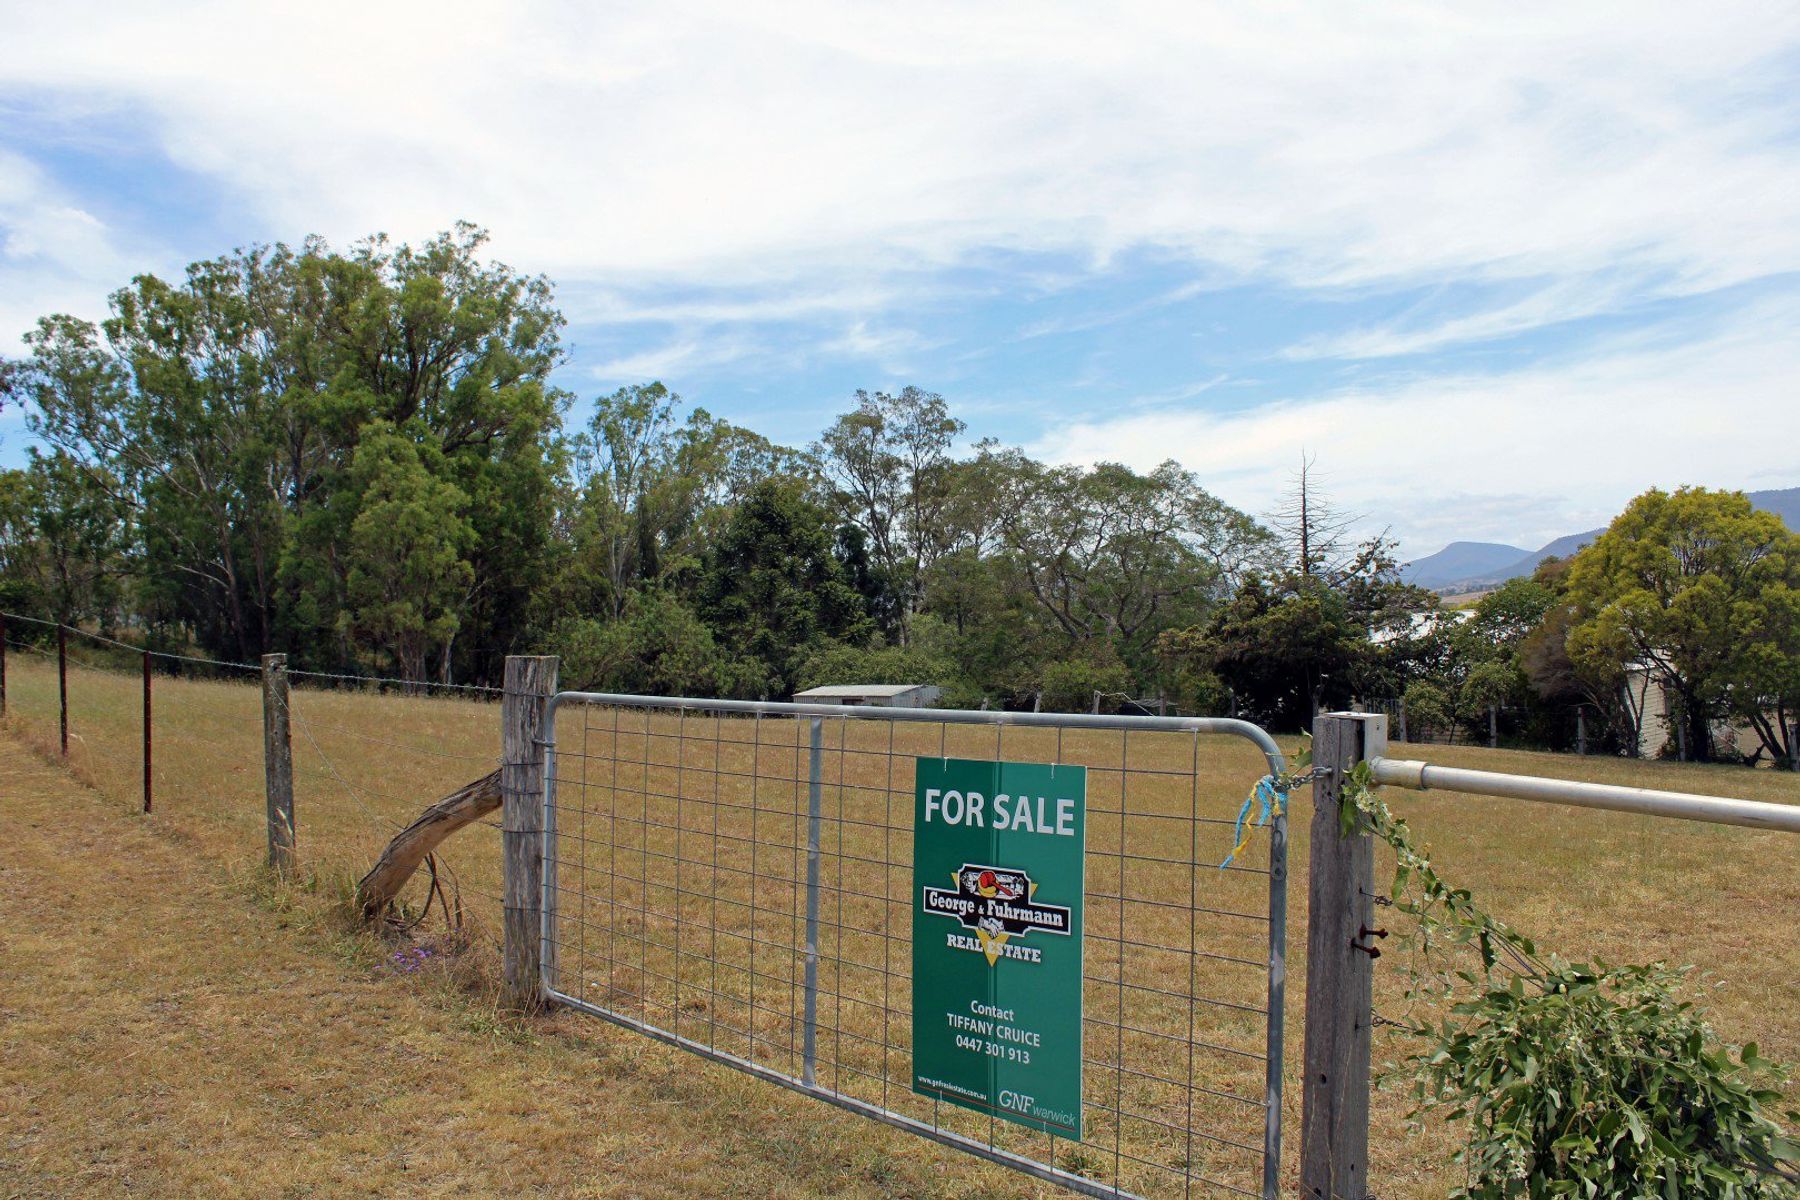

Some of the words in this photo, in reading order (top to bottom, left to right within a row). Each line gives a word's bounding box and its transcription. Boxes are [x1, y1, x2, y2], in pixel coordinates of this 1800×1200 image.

[925, 788, 985, 828] FOR
[992, 793, 1075, 837] SALE
[929, 891, 975, 916] George
[978, 904, 985, 914] &
[986, 901, 1064, 927] Fuhrmann
[946, 933, 983, 953] REAL
[987, 939, 1042, 963] ESTATE
[970, 1000, 1015, 1022] Contact
[946, 1012, 994, 1037] TIFFANY
[996, 1025, 1041, 1047] CRUICE
[956, 1034, 983, 1053] 0447
[985, 1041, 1005, 1058] 301
[1008, 1048, 1031, 1065] 913
[999, 1089, 1034, 1113] GNF
[1032, 1105, 1076, 1127] warwick
